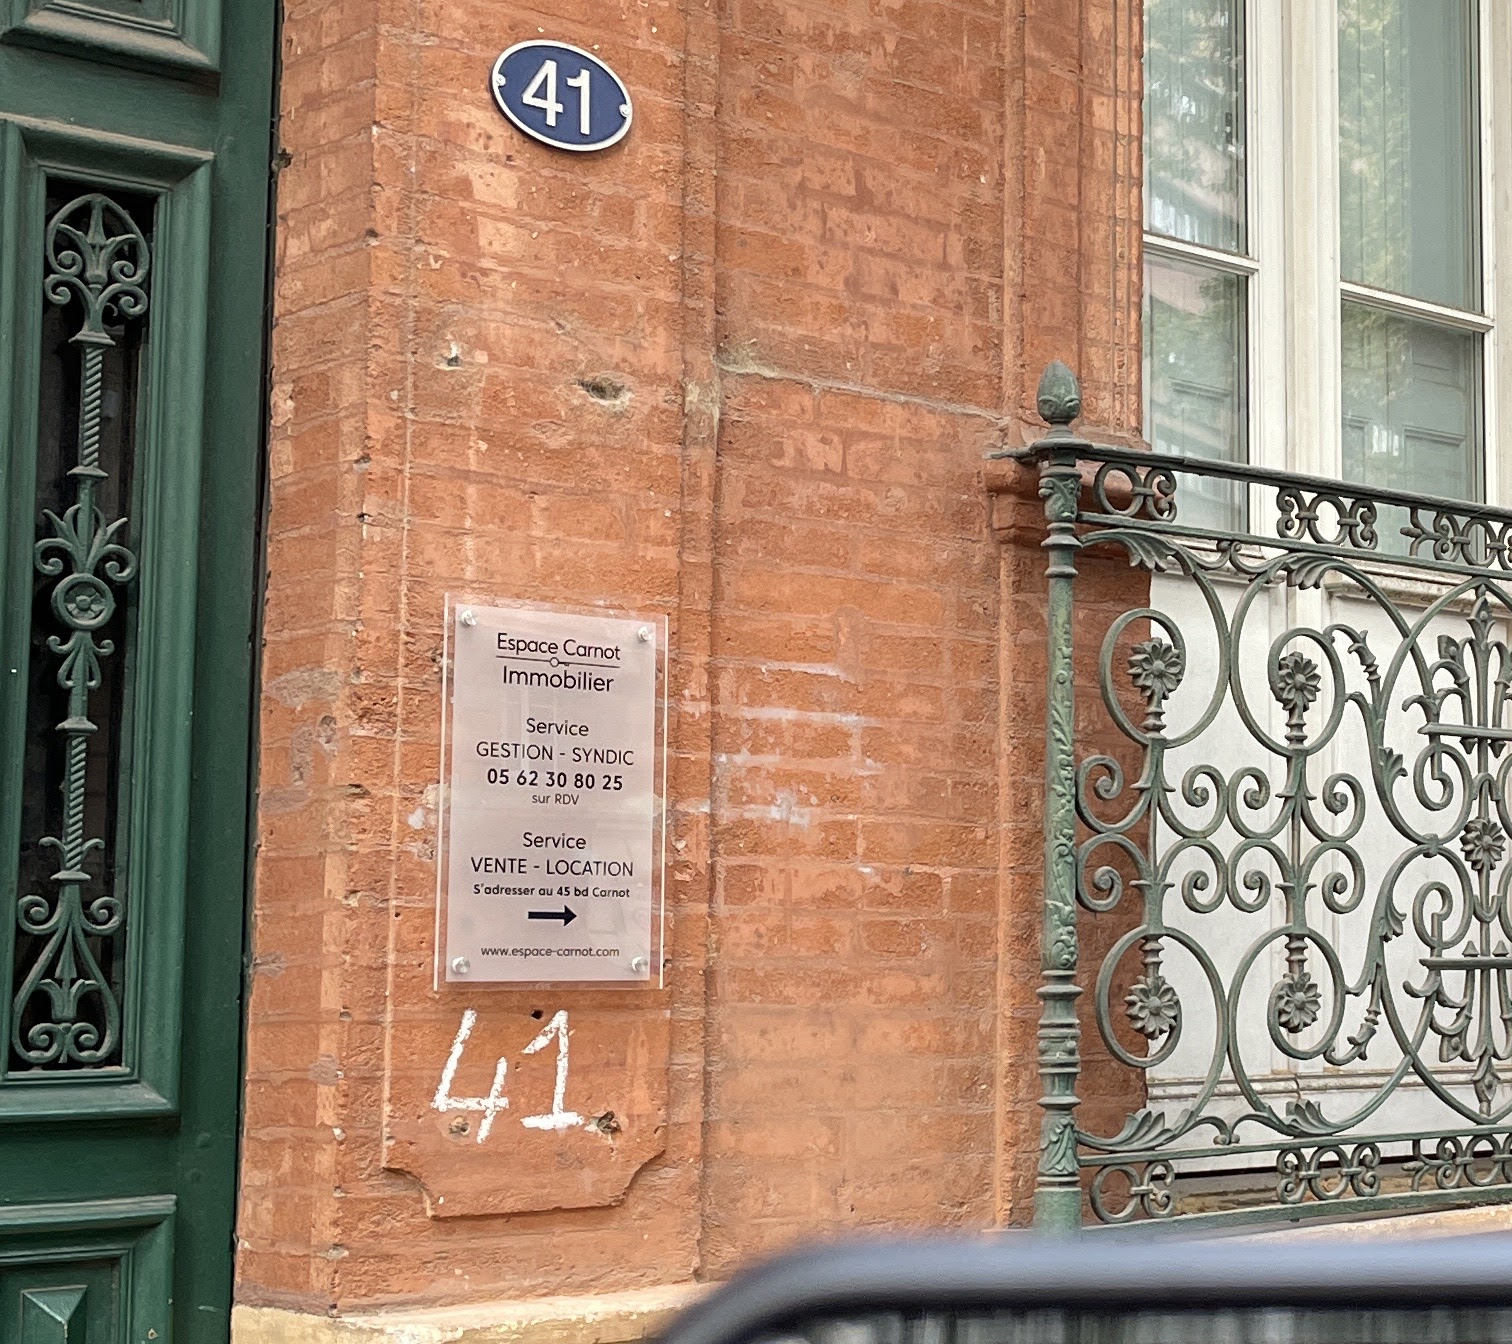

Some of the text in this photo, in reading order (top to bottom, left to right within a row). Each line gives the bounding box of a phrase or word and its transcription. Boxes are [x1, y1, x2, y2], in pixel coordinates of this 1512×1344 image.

[521, 58, 591, 136] 41
[497, 632, 621, 661] Espace Carnot
[503, 665, 615, 692] Immobilier
[526, 717, 589, 737] Service
[476, 741, 553, 761] GESTION
[572, 747, 635, 766] SYNDIC
[487, 768, 623, 791] 05 62 30 80 25
[531, 793, 580, 806] sur RDV
[522, 831, 587, 850] Service
[470, 856, 528, 874] VENTE
[546, 859, 634, 877] LOCATION
[473, 883, 630, 898] S'adresser au 45 bd Carnot
[480, 946, 620, 959] www.espace-carnot.com
[430, 1009, 585, 1144] 41
